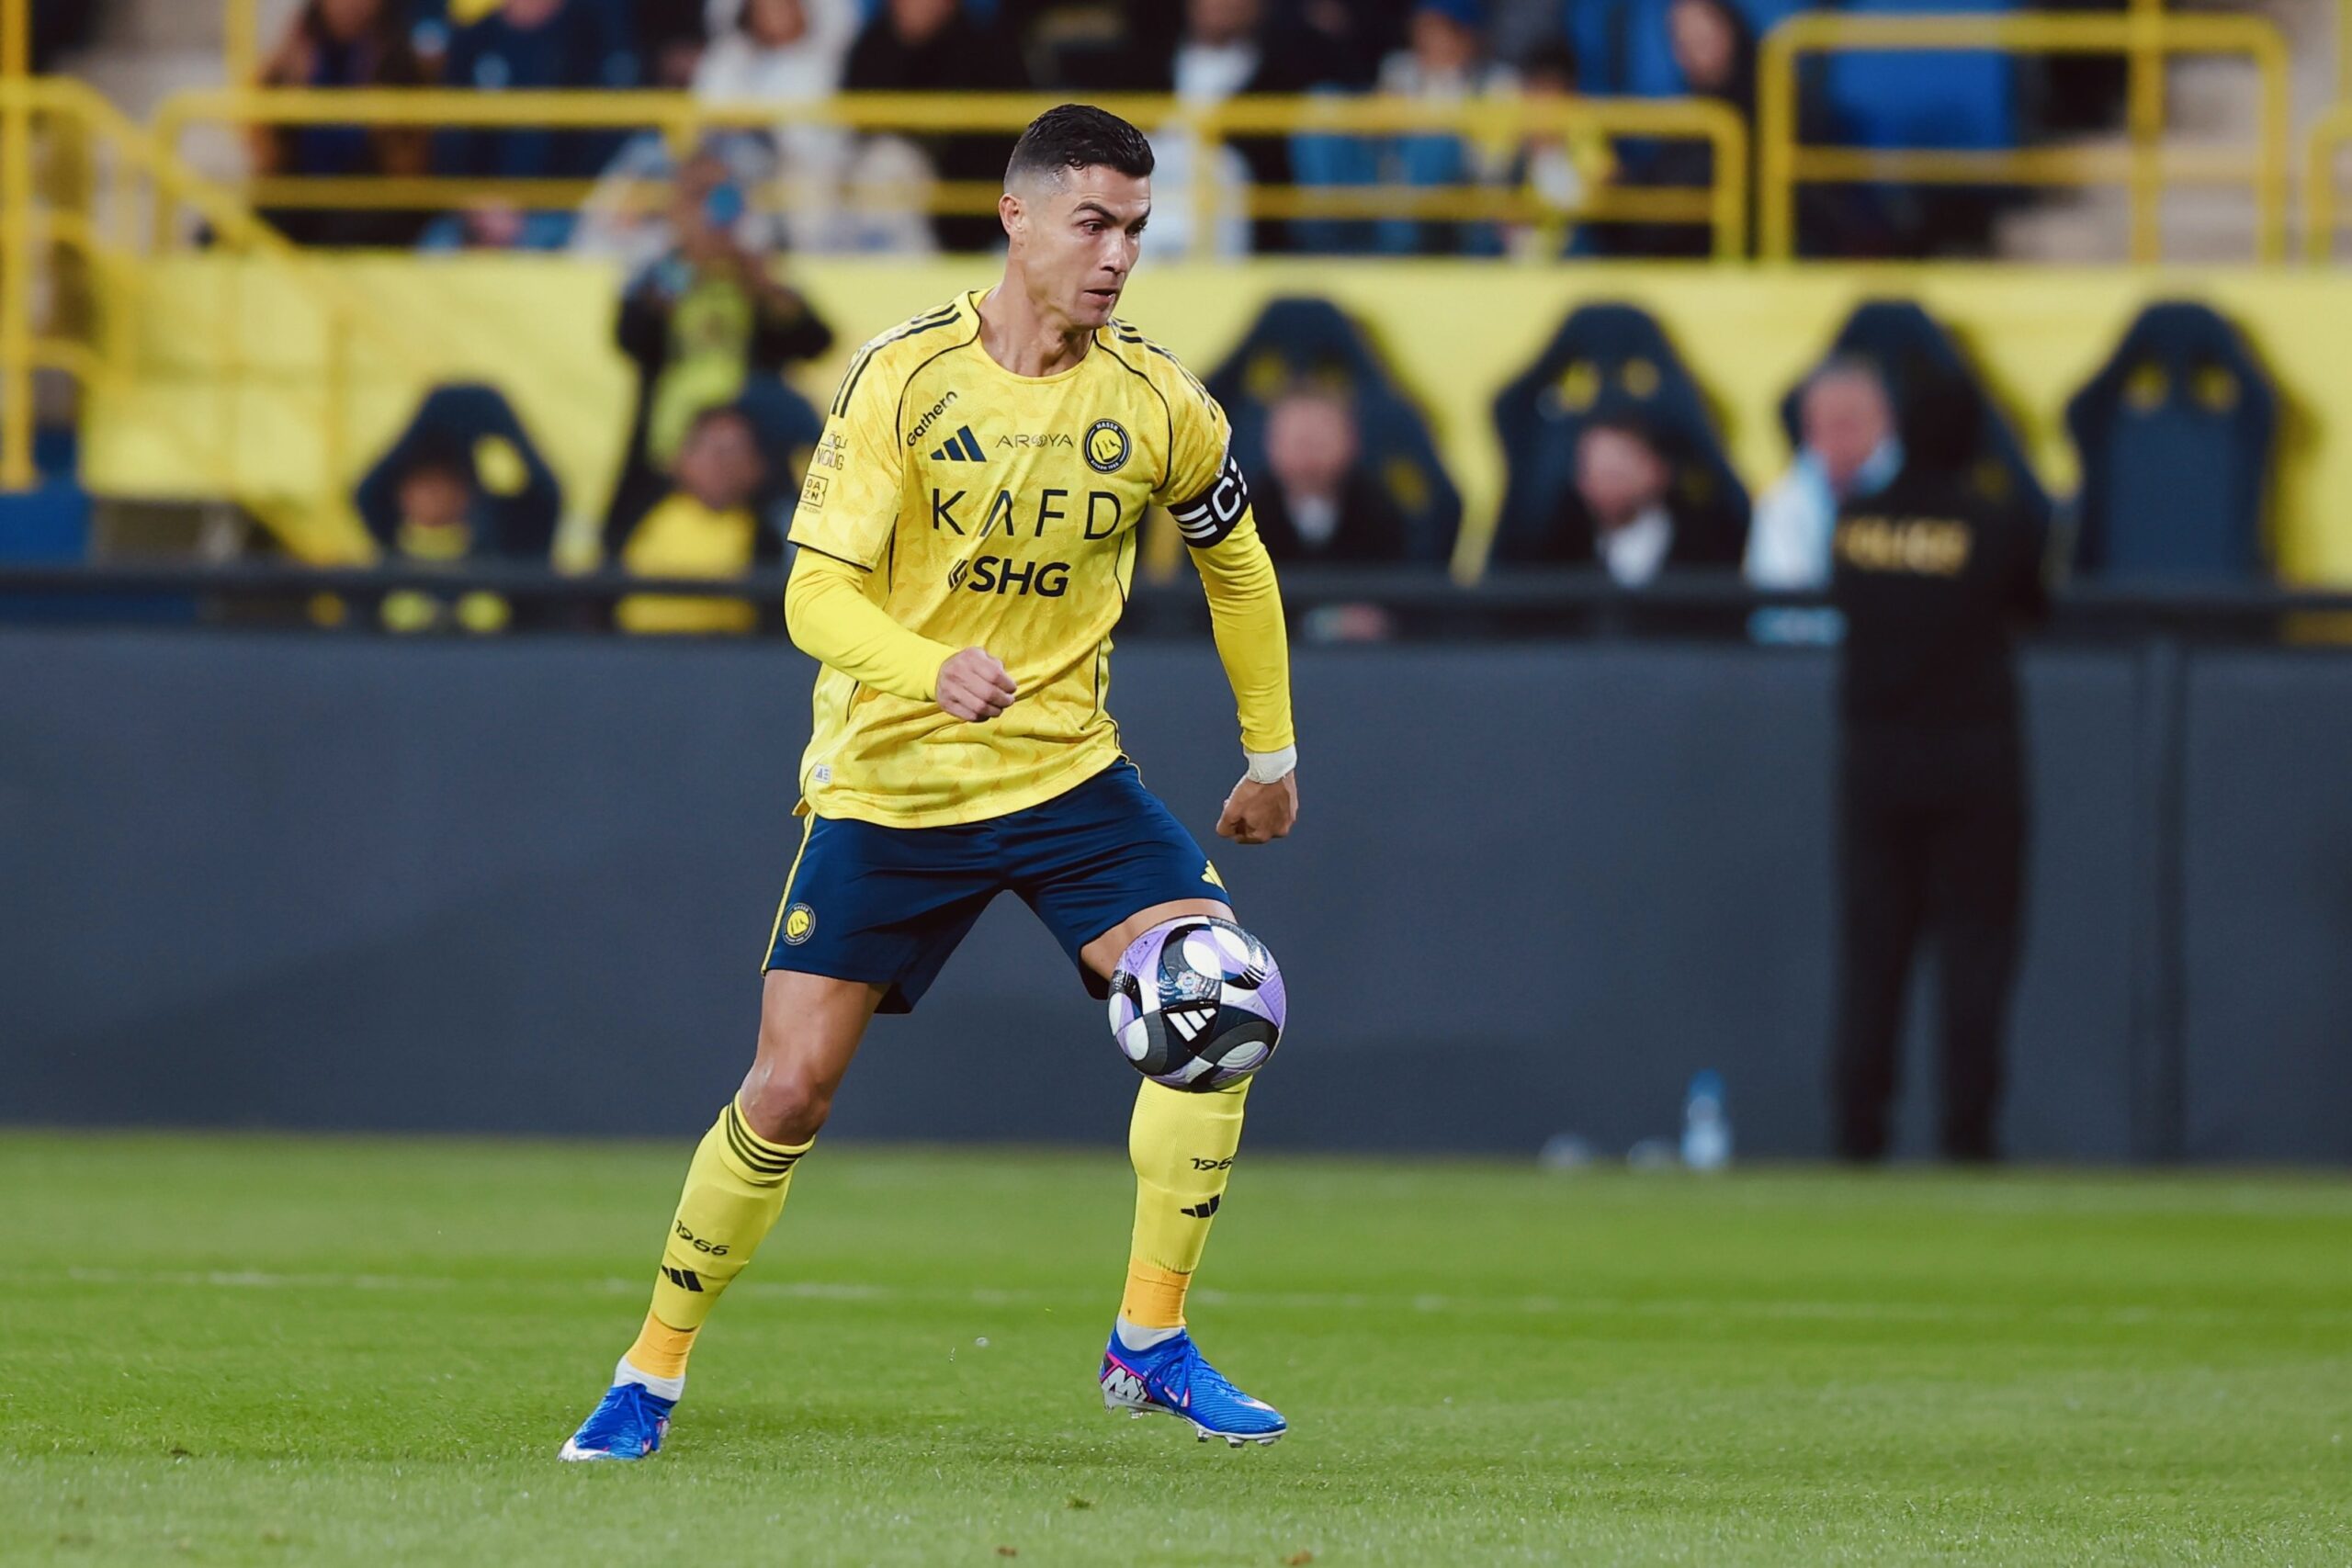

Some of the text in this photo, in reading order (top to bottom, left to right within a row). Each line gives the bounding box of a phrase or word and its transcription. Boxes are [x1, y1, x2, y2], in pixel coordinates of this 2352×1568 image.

[906, 390, 958, 447] Gathern
[932, 488, 1122, 540] KAFD
[967, 555, 1071, 597] SHG
